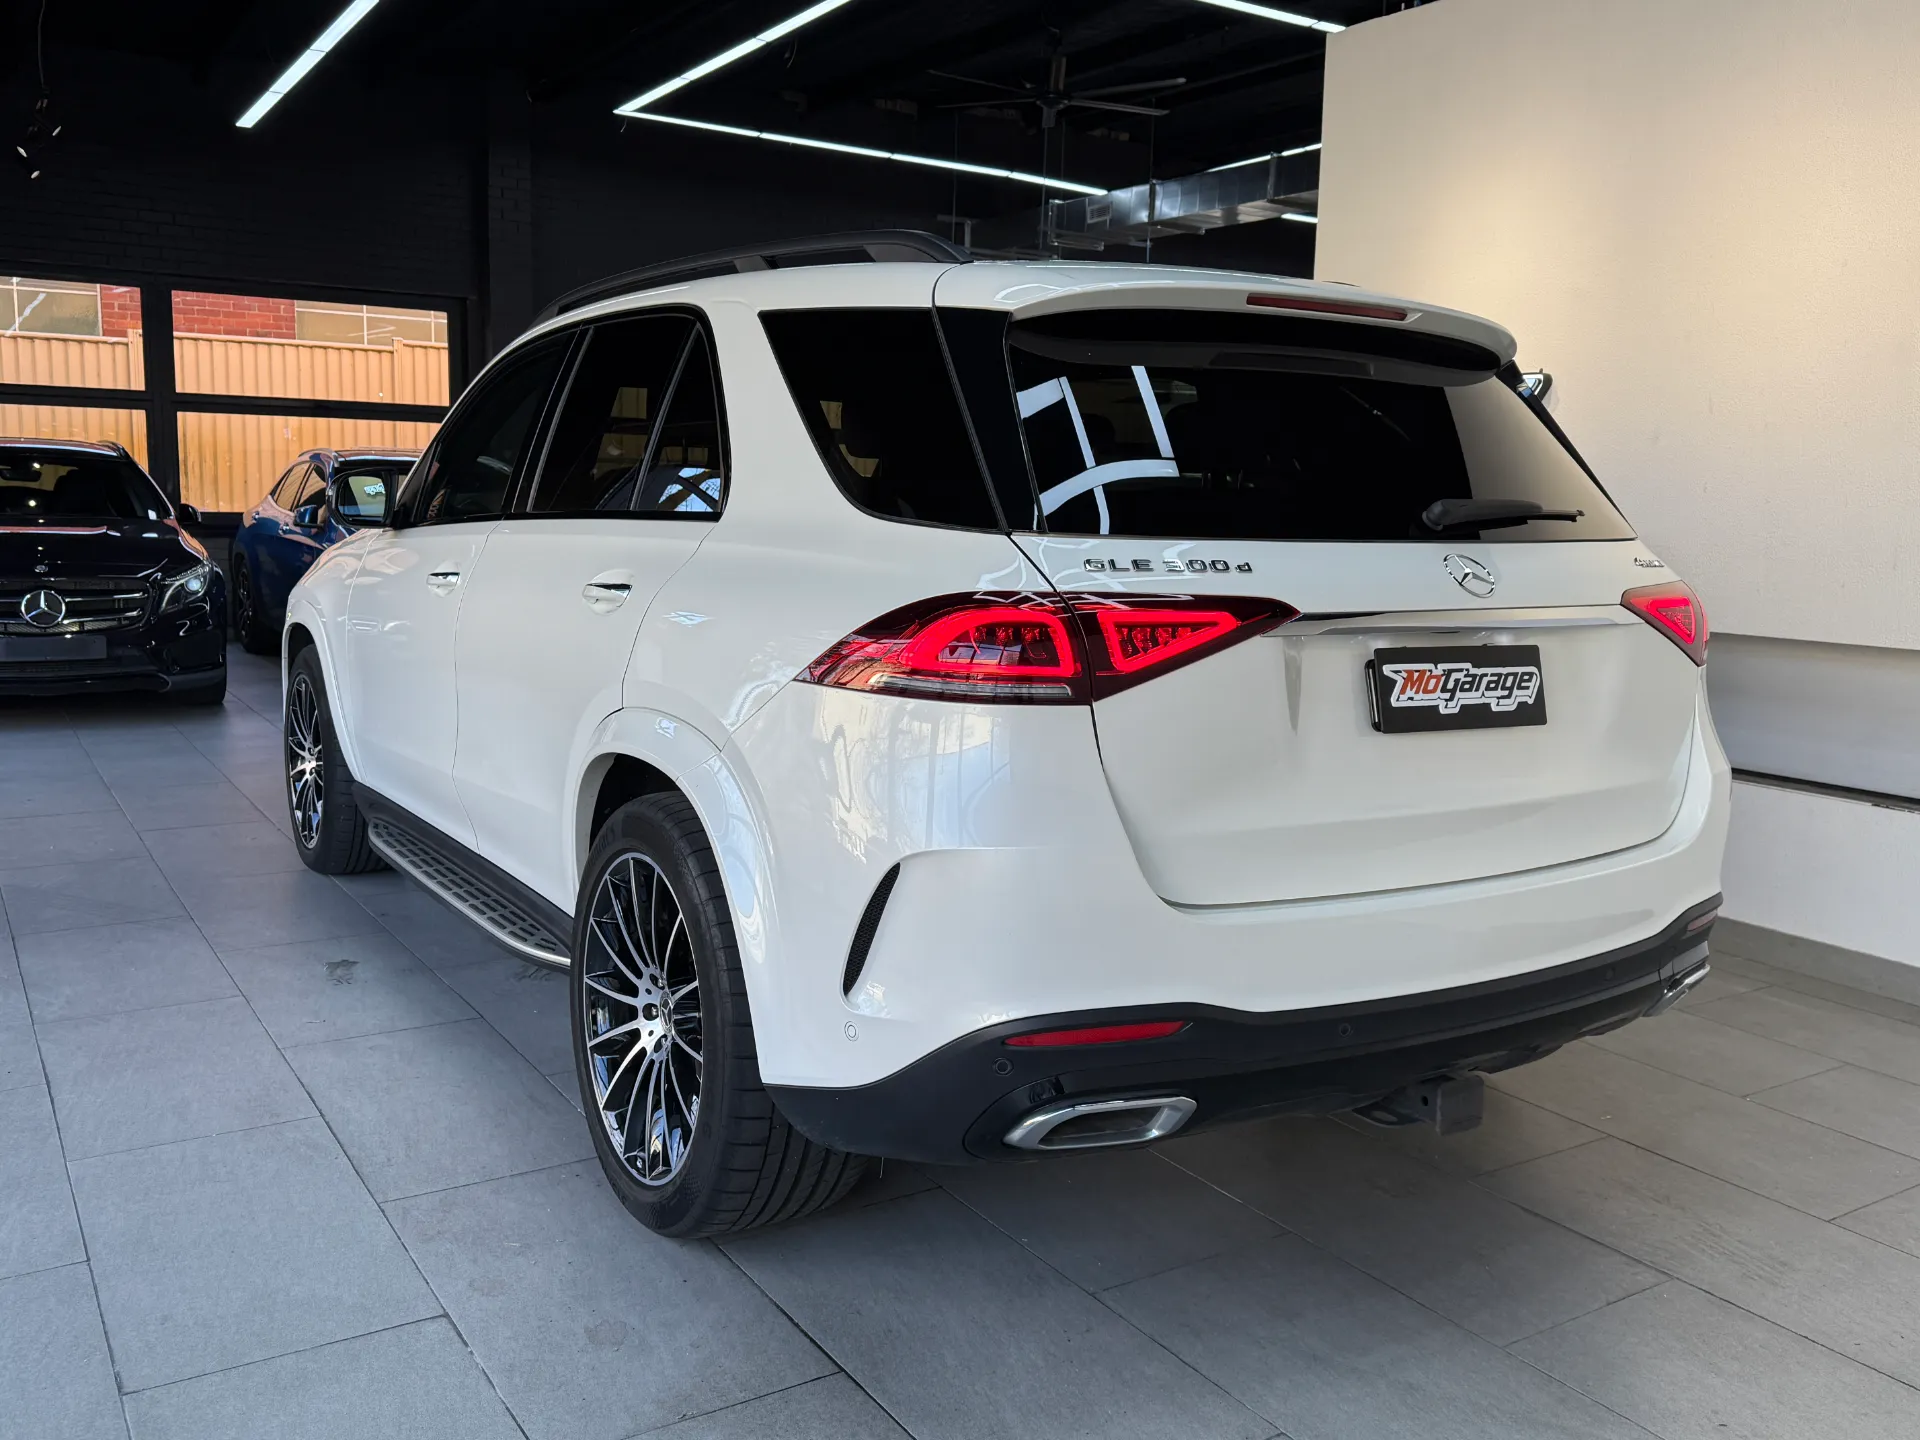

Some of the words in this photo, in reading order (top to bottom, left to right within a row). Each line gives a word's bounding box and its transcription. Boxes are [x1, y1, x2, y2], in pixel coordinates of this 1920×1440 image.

[1084, 558, 1154, 572] GLE
[1162, 558, 1231, 573] 300
[1235, 562, 1253, 573] d
[1394, 668, 1537, 704] MoGarage
